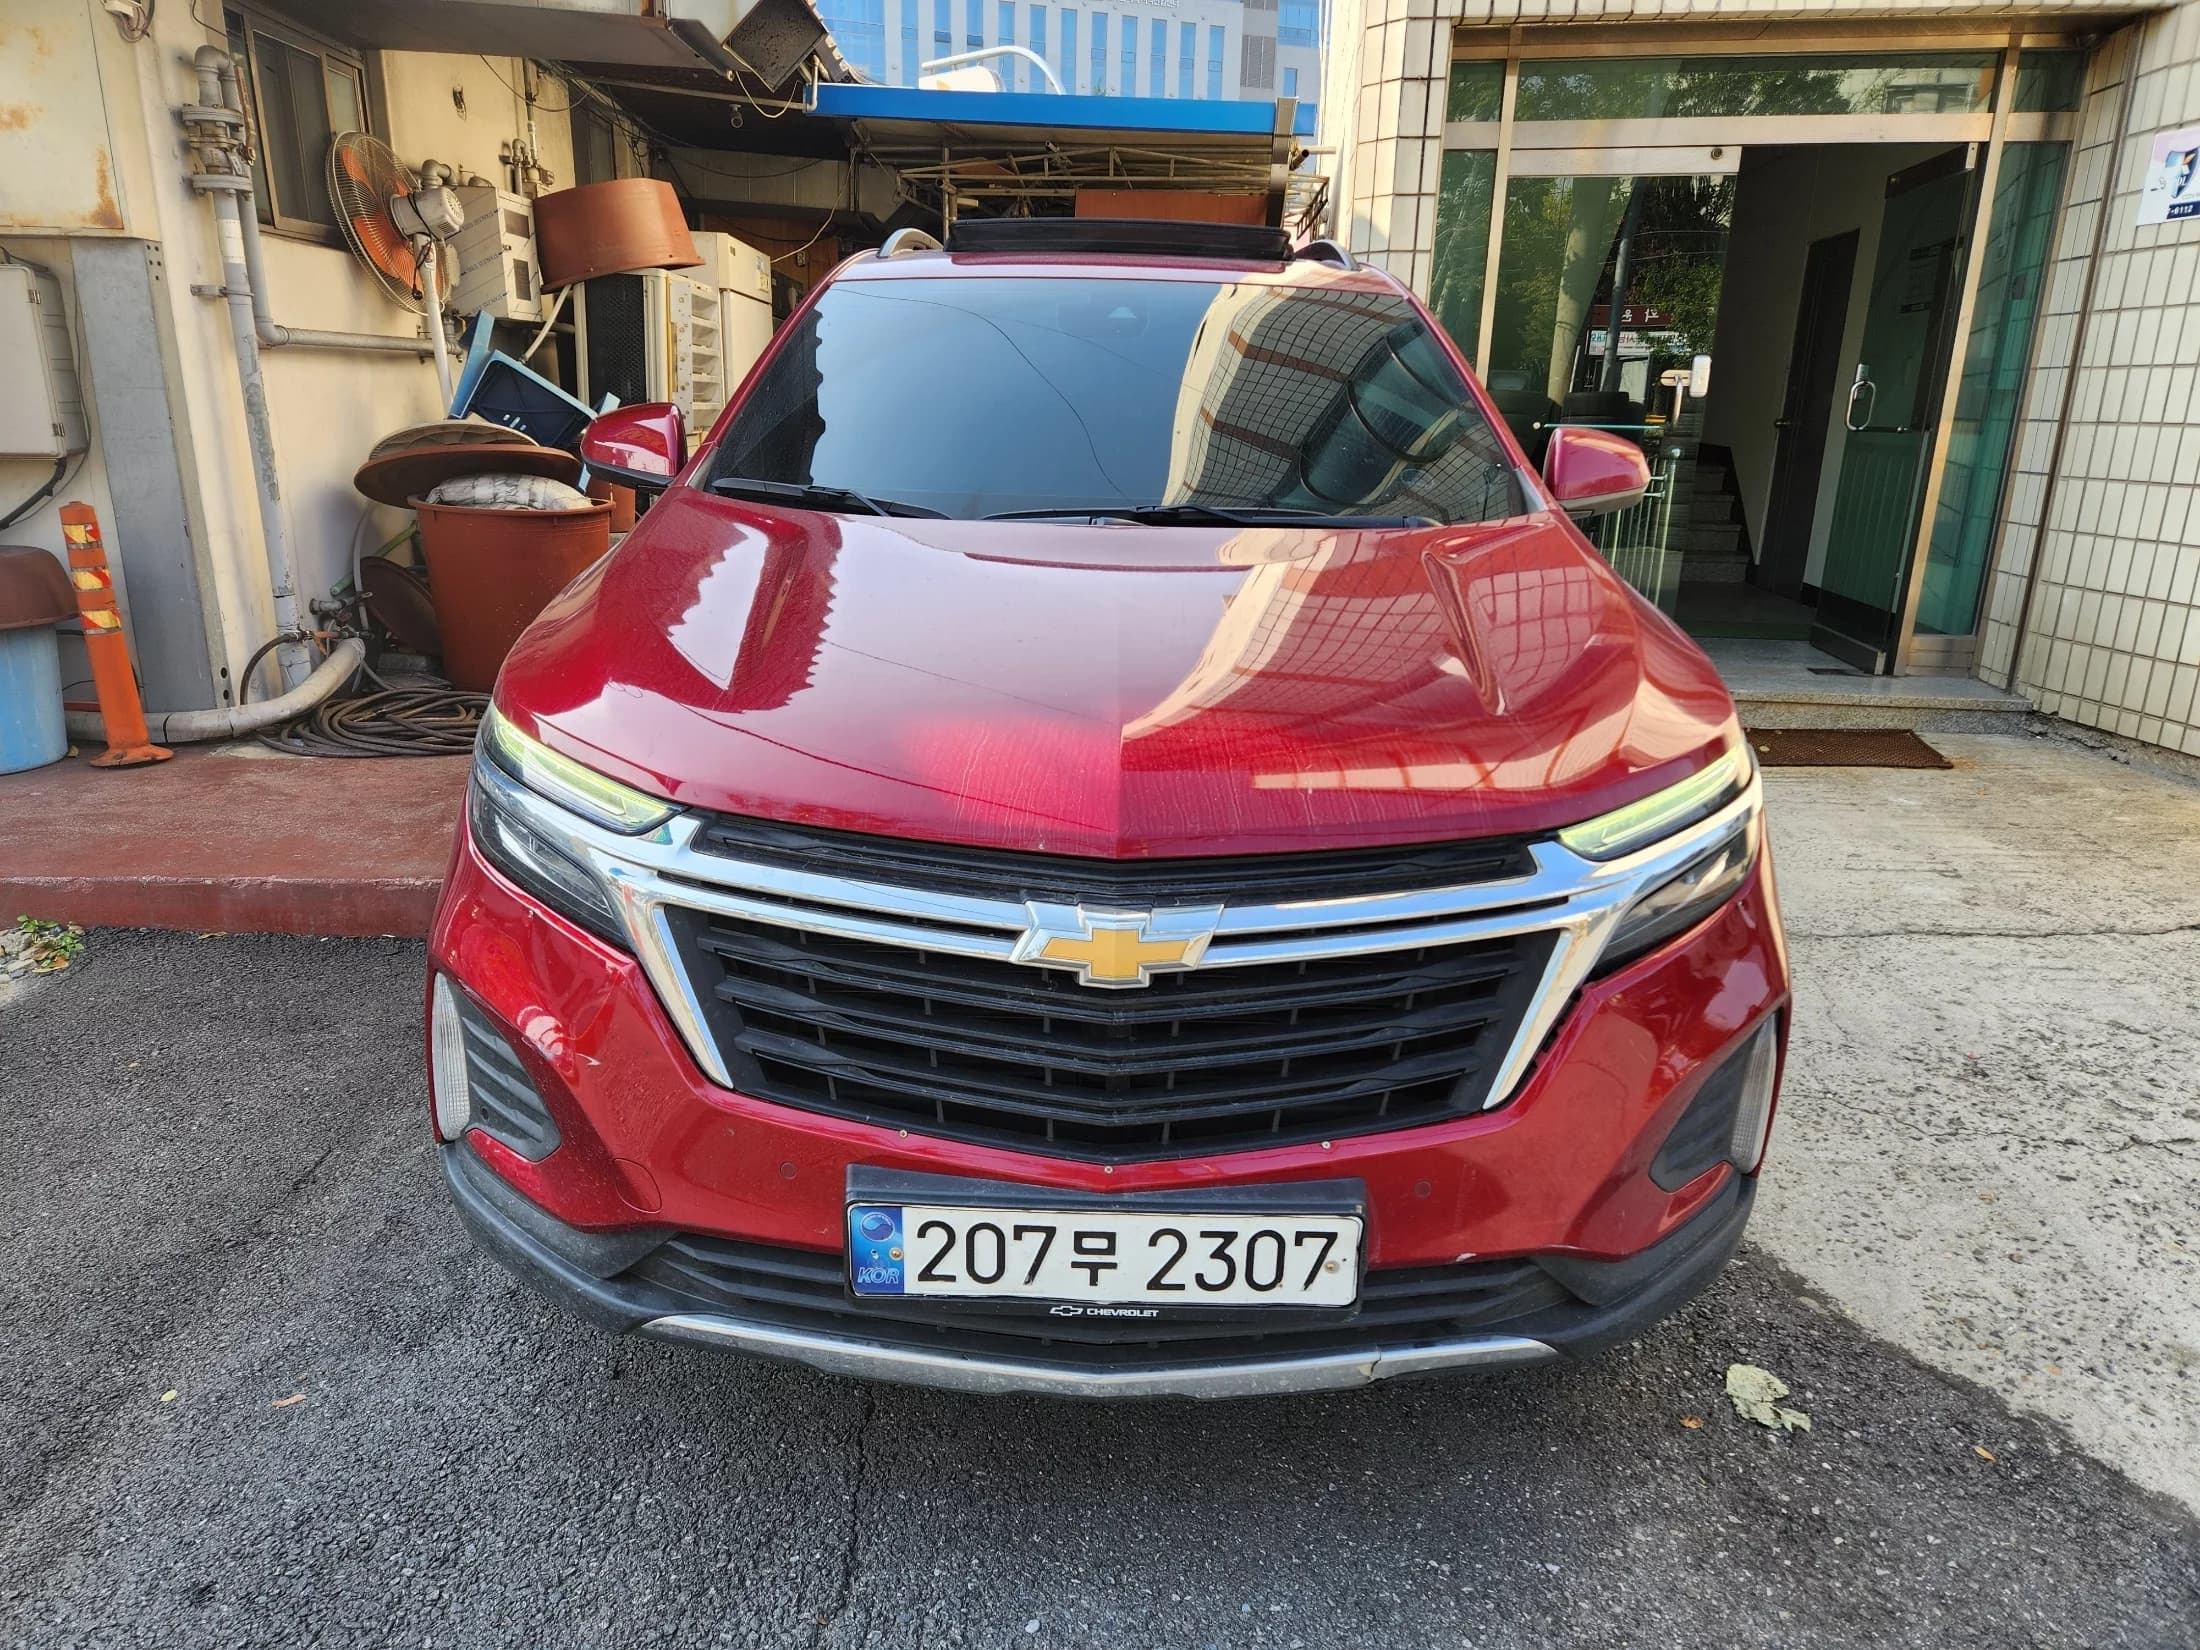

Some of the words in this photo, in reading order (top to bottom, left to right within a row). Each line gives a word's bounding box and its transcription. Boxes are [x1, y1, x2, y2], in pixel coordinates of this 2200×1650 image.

[916, 1220, 1117, 1287] 207무
[1147, 1229, 1338, 1292] 2307
[858, 1266, 900, 1284] KOR
[1086, 1307, 1159, 1317] CHEVROLET
